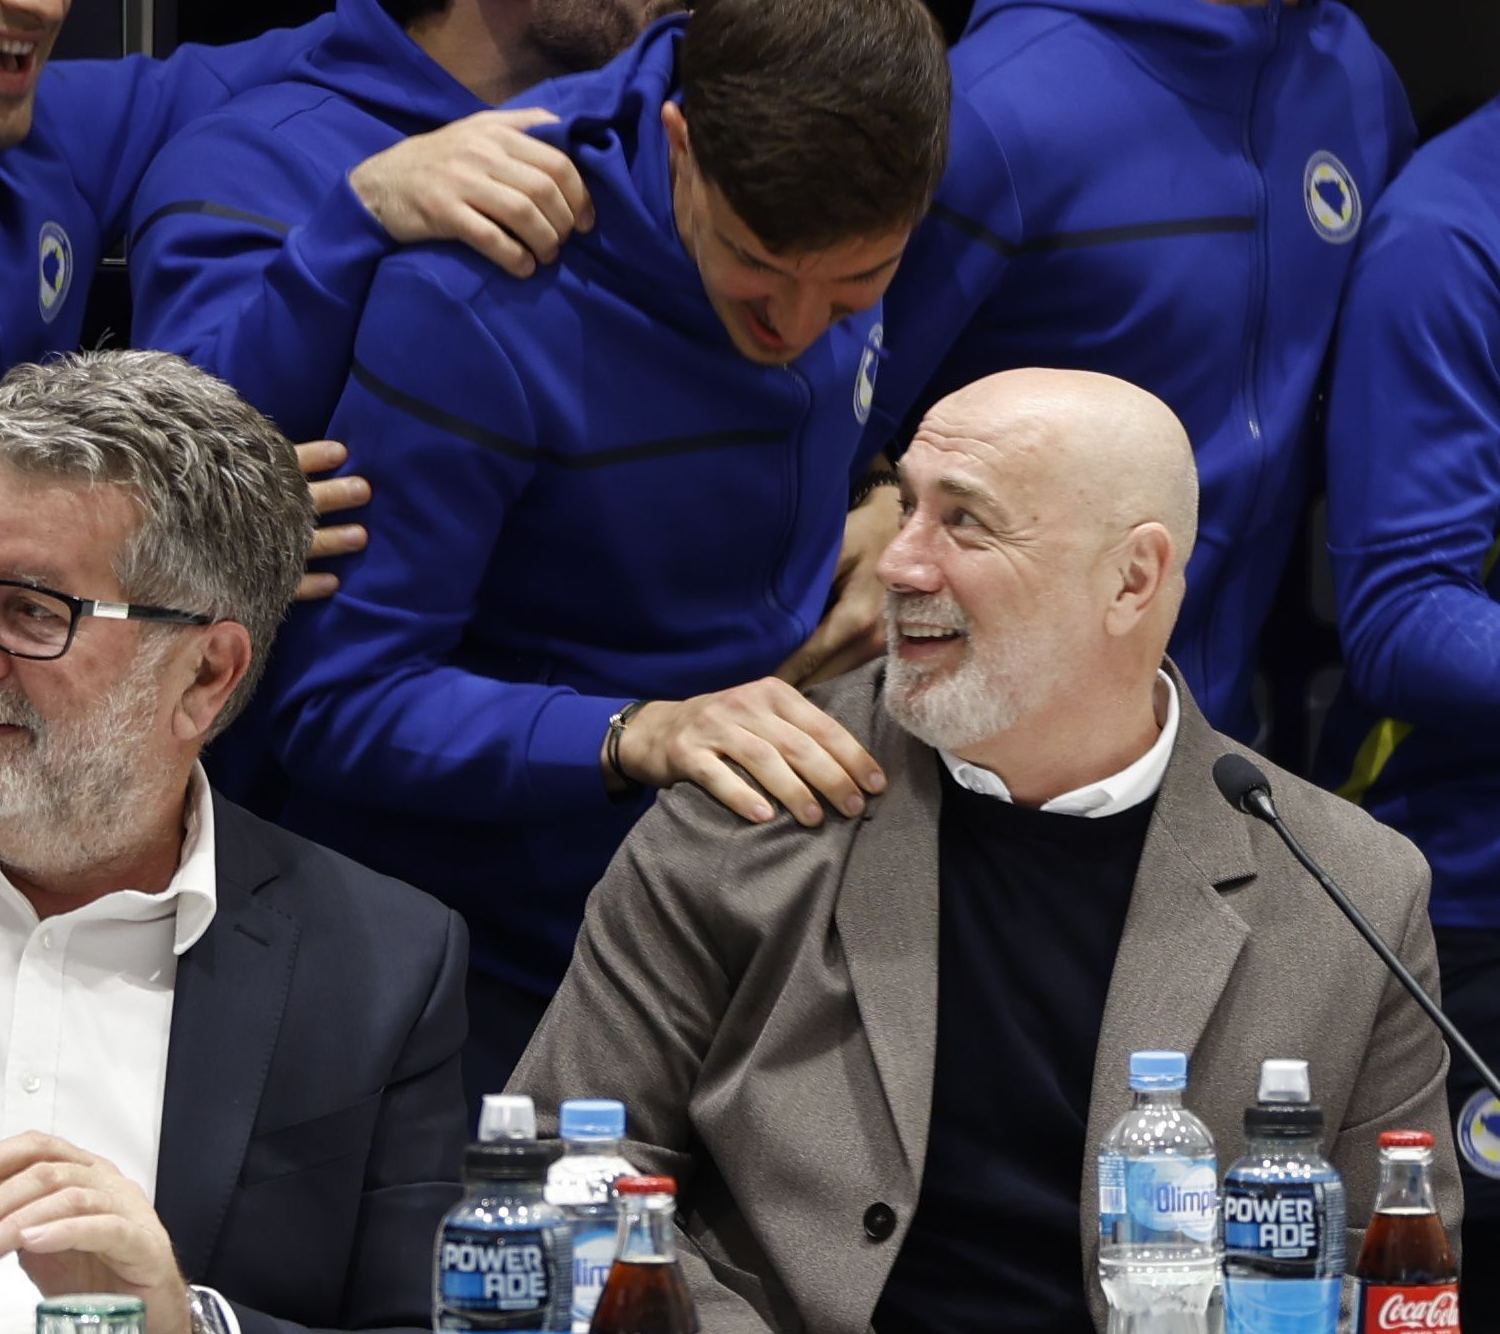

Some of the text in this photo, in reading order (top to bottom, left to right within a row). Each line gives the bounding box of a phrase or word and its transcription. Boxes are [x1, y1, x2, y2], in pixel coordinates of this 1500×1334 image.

[1225, 1197, 1315, 1223] POWER
[1259, 1223, 1317, 1248] ADE
[442, 1243, 543, 1273] POWER
[484, 1272, 548, 1300] ADE
